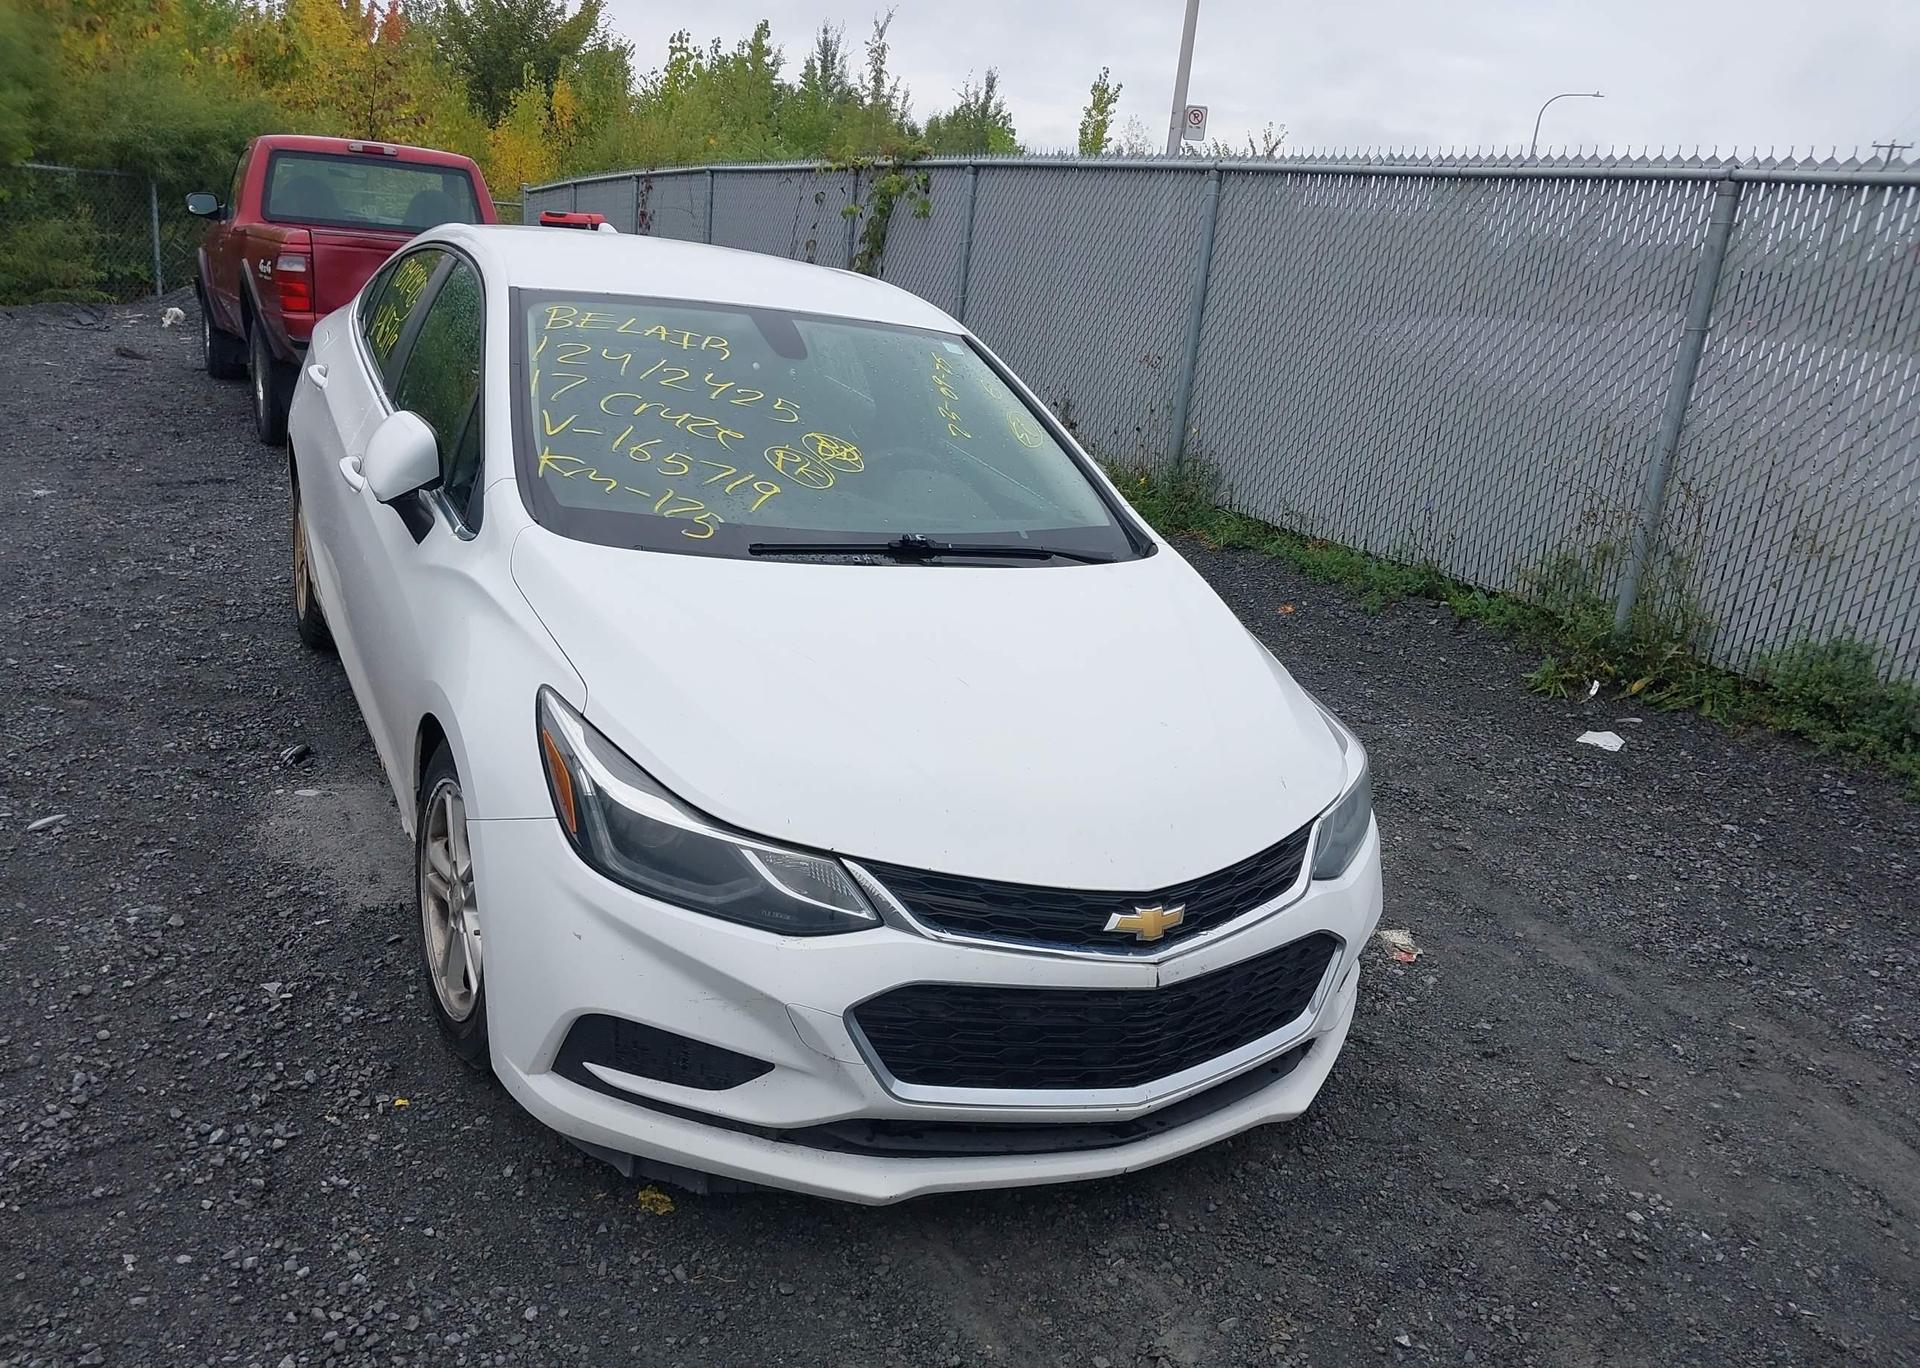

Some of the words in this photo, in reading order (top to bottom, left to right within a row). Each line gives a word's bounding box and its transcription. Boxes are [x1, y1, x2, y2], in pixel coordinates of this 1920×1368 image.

[544, 305, 731, 361] BELAIR
[531, 369, 588, 401] 17
[599, 392, 745, 452] Cruze
